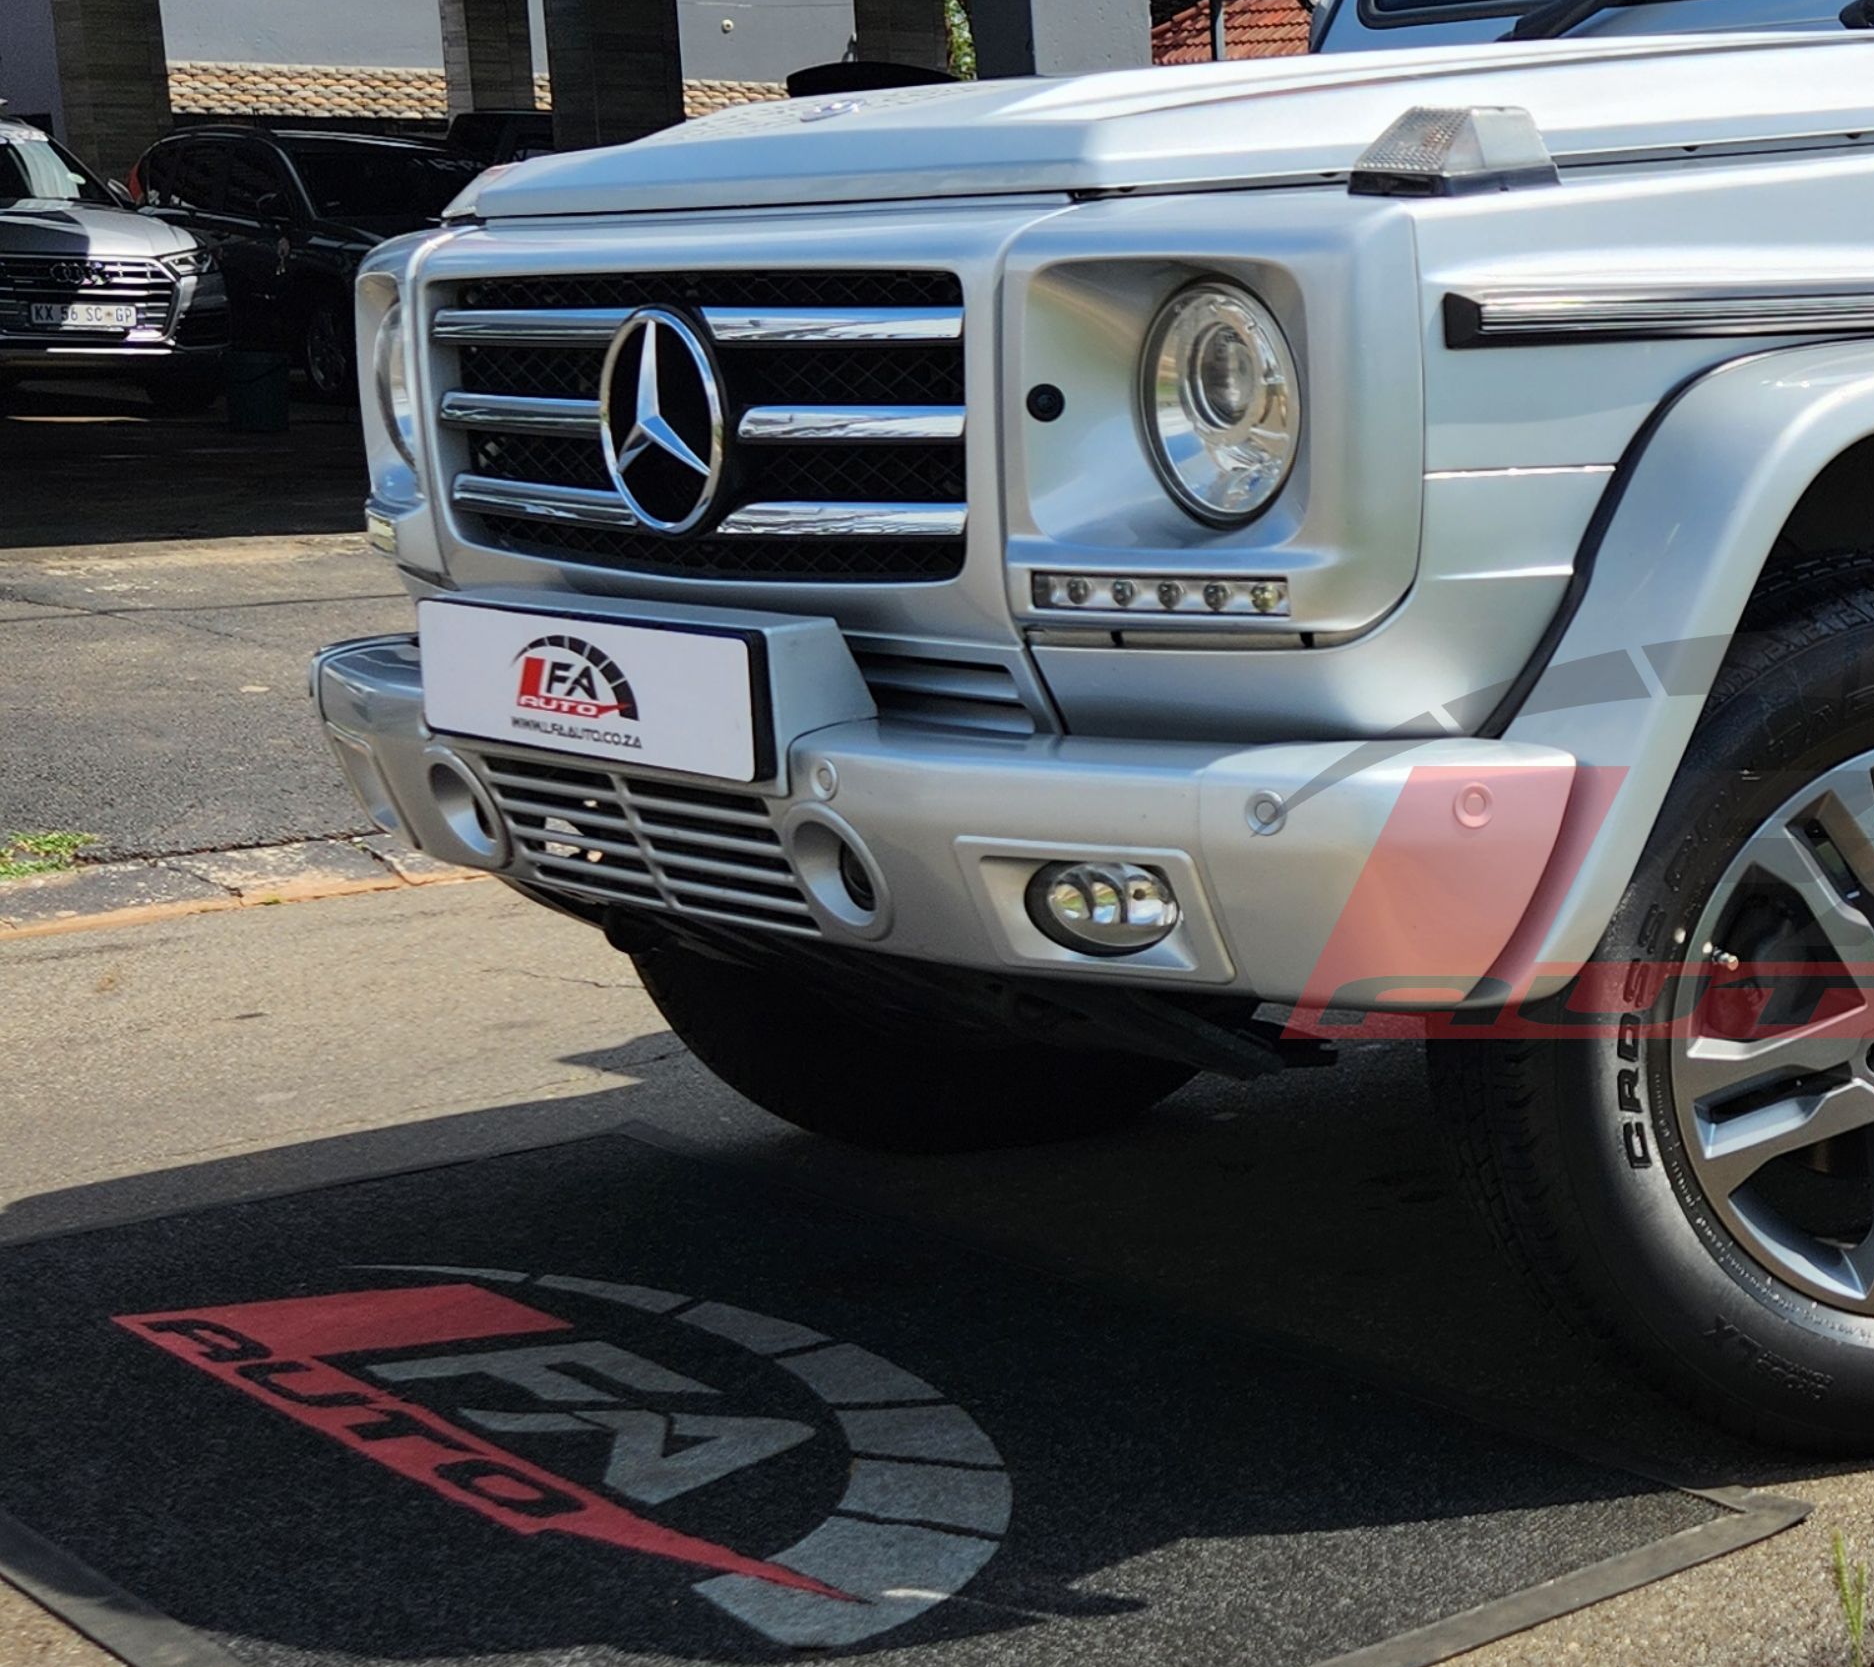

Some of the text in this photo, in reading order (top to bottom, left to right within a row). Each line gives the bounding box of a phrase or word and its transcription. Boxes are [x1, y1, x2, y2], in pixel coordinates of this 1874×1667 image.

[33, 305, 133, 323] KX 56 SC GP
[519, 695, 599, 716] AUTO
[140, 1319, 588, 1518] AUTO
